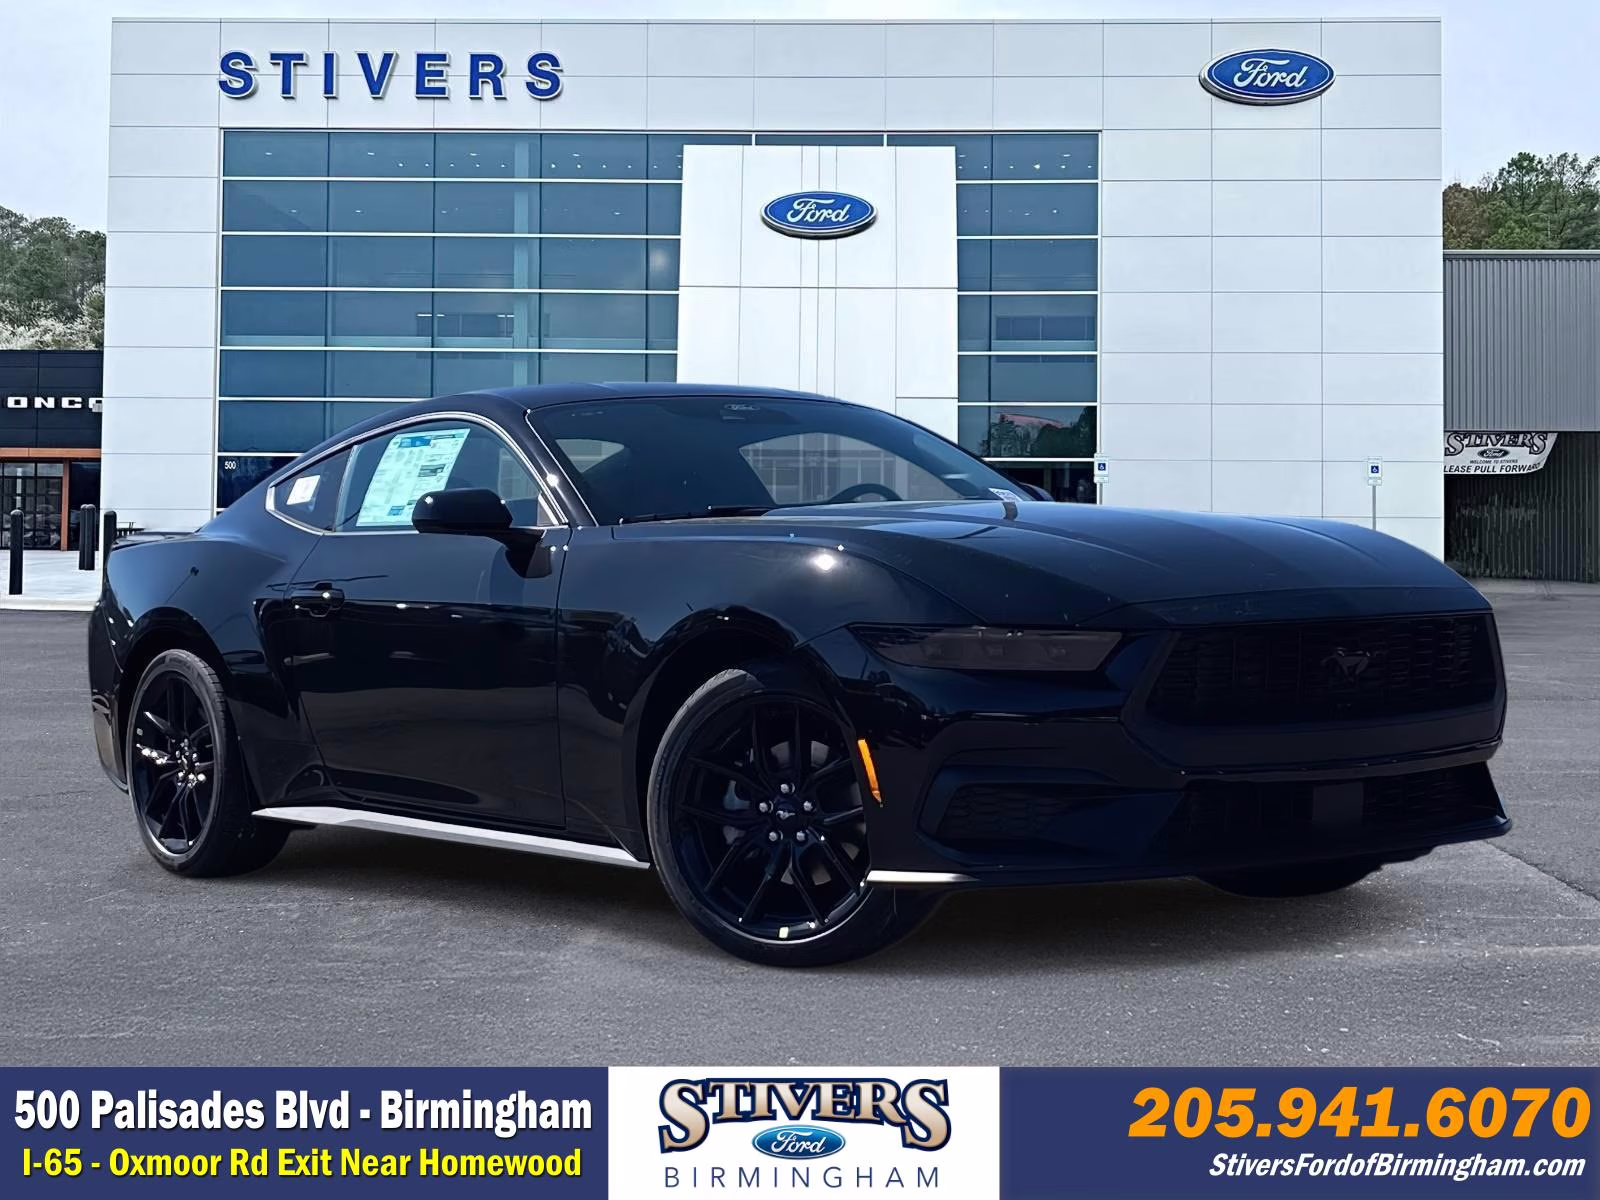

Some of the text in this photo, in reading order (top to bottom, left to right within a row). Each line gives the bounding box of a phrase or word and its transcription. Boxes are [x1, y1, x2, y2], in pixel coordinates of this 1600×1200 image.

[218, 51, 564, 100] STIVERS
[1233, 58, 1308, 88] Ford
[786, 198, 851, 223] Ford
[1444, 431, 1547, 456] STIVERS
[224, 461, 237, 469] 500
[1444, 465, 1472, 473] LEASE
[1474, 465, 1497, 473] PULL
